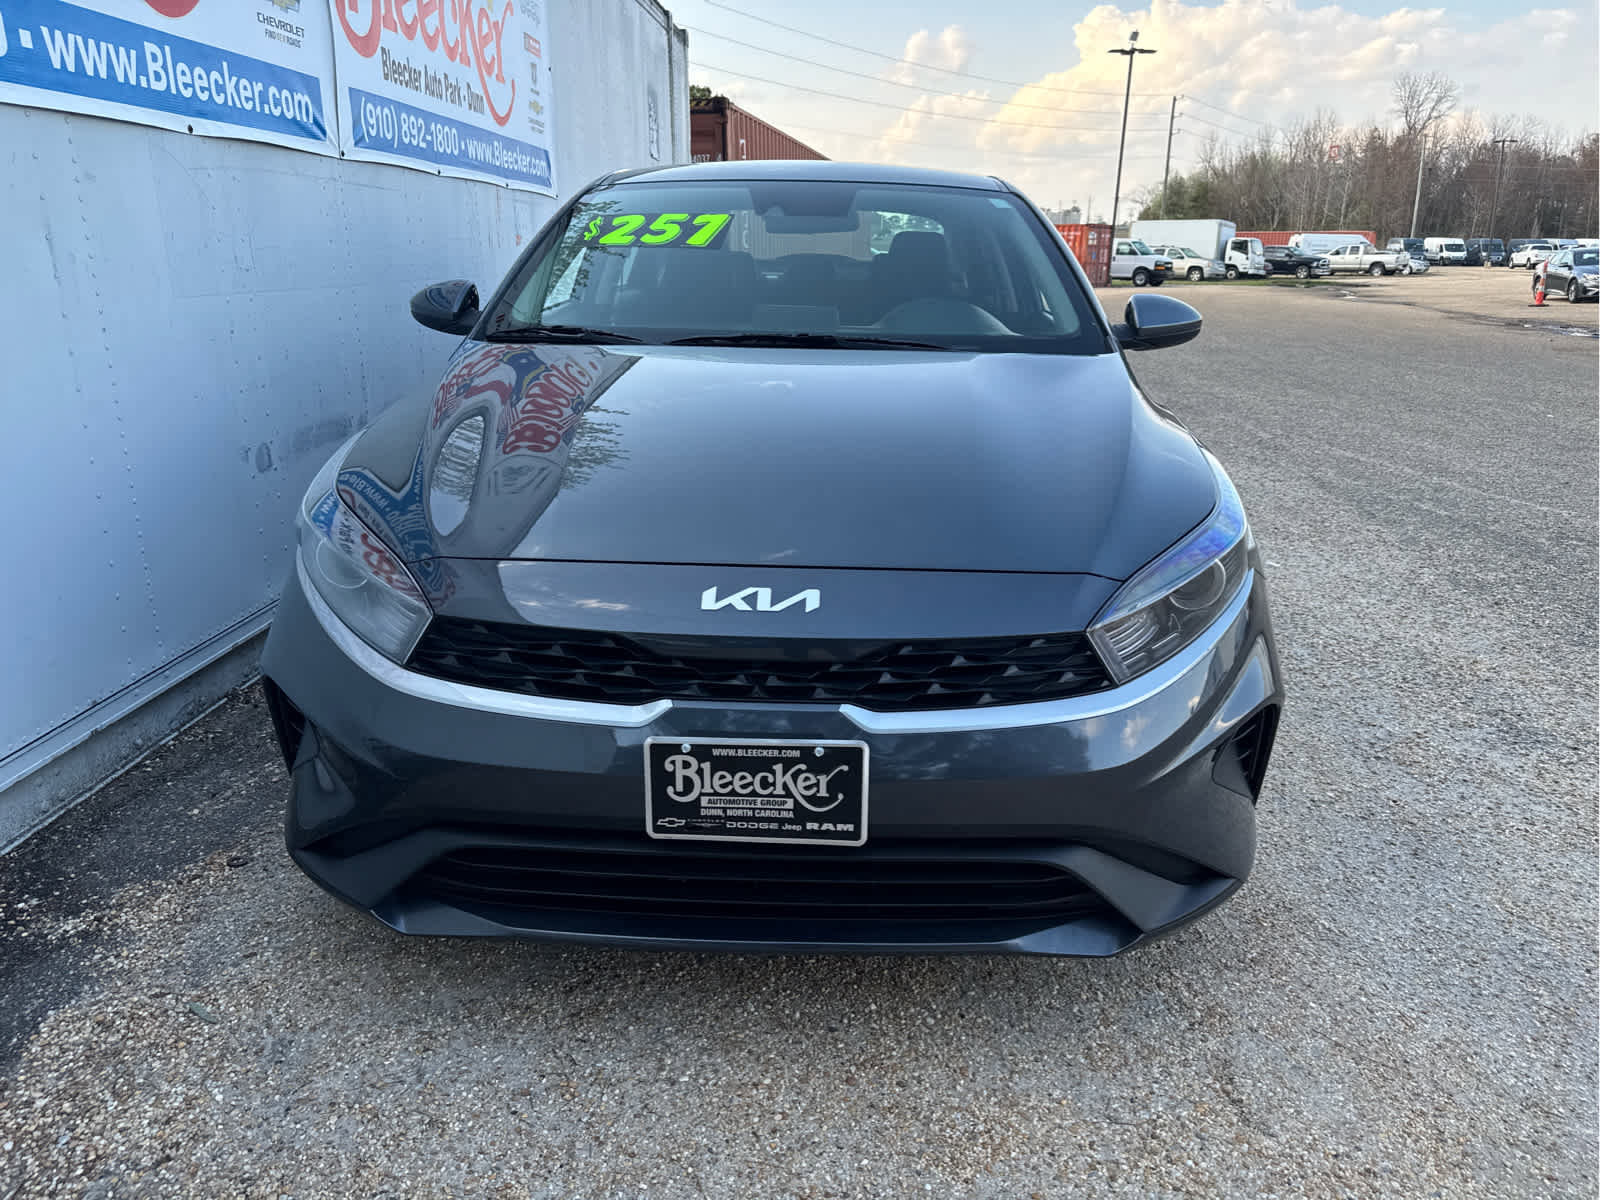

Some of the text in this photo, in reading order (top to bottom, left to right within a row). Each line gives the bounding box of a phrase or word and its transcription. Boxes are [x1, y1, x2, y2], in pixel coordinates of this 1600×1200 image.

[256, 12, 305, 38] CHEVROLET
[40, 25, 314, 123] www.Bleecker.com
[381, 46, 485, 114] Bleecker Auto Park Dunn
[361, 97, 548, 177] (910) 892-1800 www.Bleecker.com
[712, 748, 800, 757] WWW.BLEECKER.COM
[707, 798, 788, 807] AUTOMOTIVE GROUP
[701, 808, 794, 818] DUNN, NORTH CAROLINA
[726, 821, 855, 832] DODGE Jeep RAM
